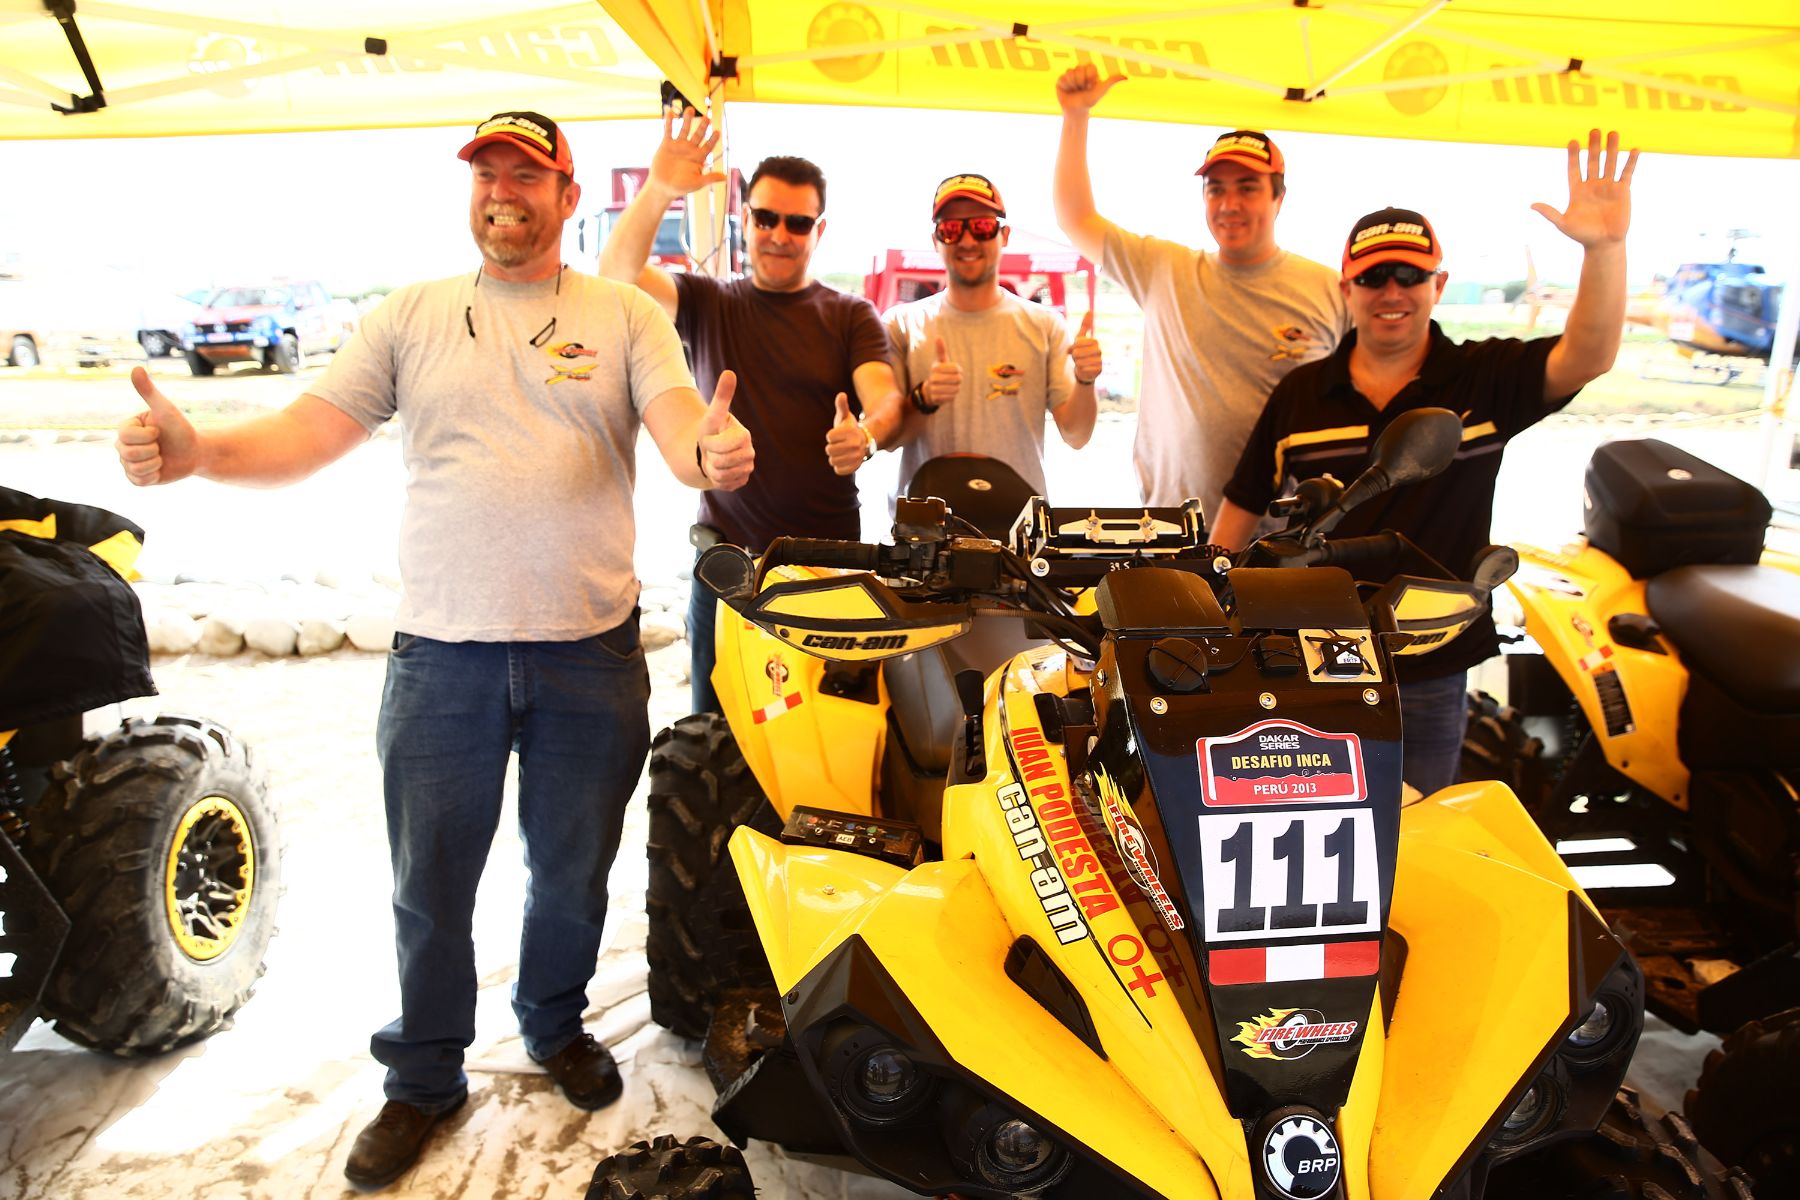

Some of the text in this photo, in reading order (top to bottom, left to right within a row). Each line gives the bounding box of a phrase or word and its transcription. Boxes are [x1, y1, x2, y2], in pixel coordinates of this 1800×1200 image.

[1354, 222, 1424, 242] can-am
[801, 634, 908, 650] can-am
[1258, 734, 1300, 743] DAKAR
[1259, 742, 1300, 751] SERIES
[1231, 753, 1332, 770] DESAFIO INCA
[1253, 781, 1317, 795] PERÚ 2013
[996, 781, 1088, 946] can-am
[1010, 727, 1164, 999] JUAN PODESTA O+
[1109, 804, 1184, 930] FIRE WHEELS
[1217, 817, 1368, 933] 111
[1259, 1021, 1356, 1041] FIRE WHEELS
[1297, 1158, 1336, 1174] BRP
